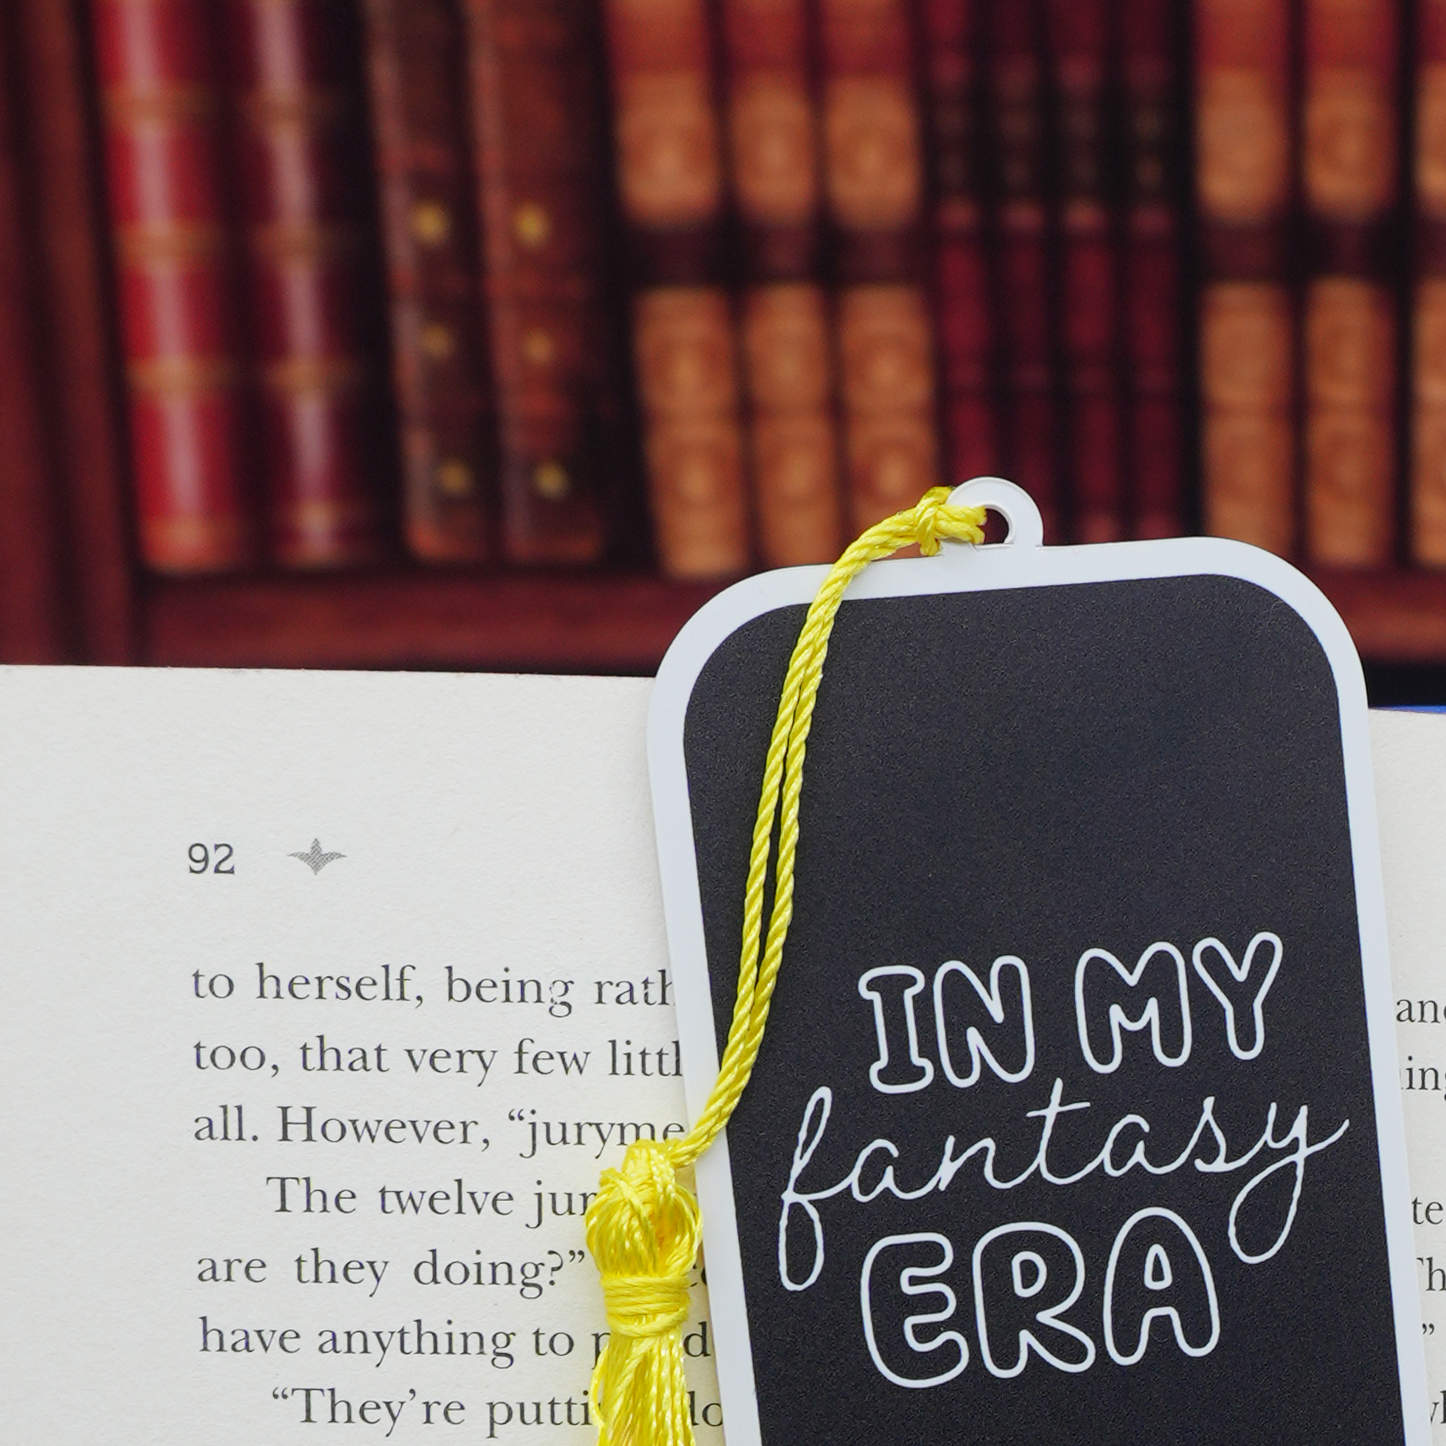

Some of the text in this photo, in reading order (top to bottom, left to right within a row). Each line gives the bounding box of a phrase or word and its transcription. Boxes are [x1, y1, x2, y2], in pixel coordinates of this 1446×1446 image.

[188, 843, 234, 874] 92
[192, 962, 574, 1018] to herself, being
[858, 932, 1283, 1094] IN MY
[194, 1035, 591, 1087] too, that very few
[195, 1105, 489, 1151] all. However,
[779, 1078, 1350, 1291] fantasy
[198, 1247, 585, 1299] are they doing?”
[861, 1207, 1220, 1388] ERA
